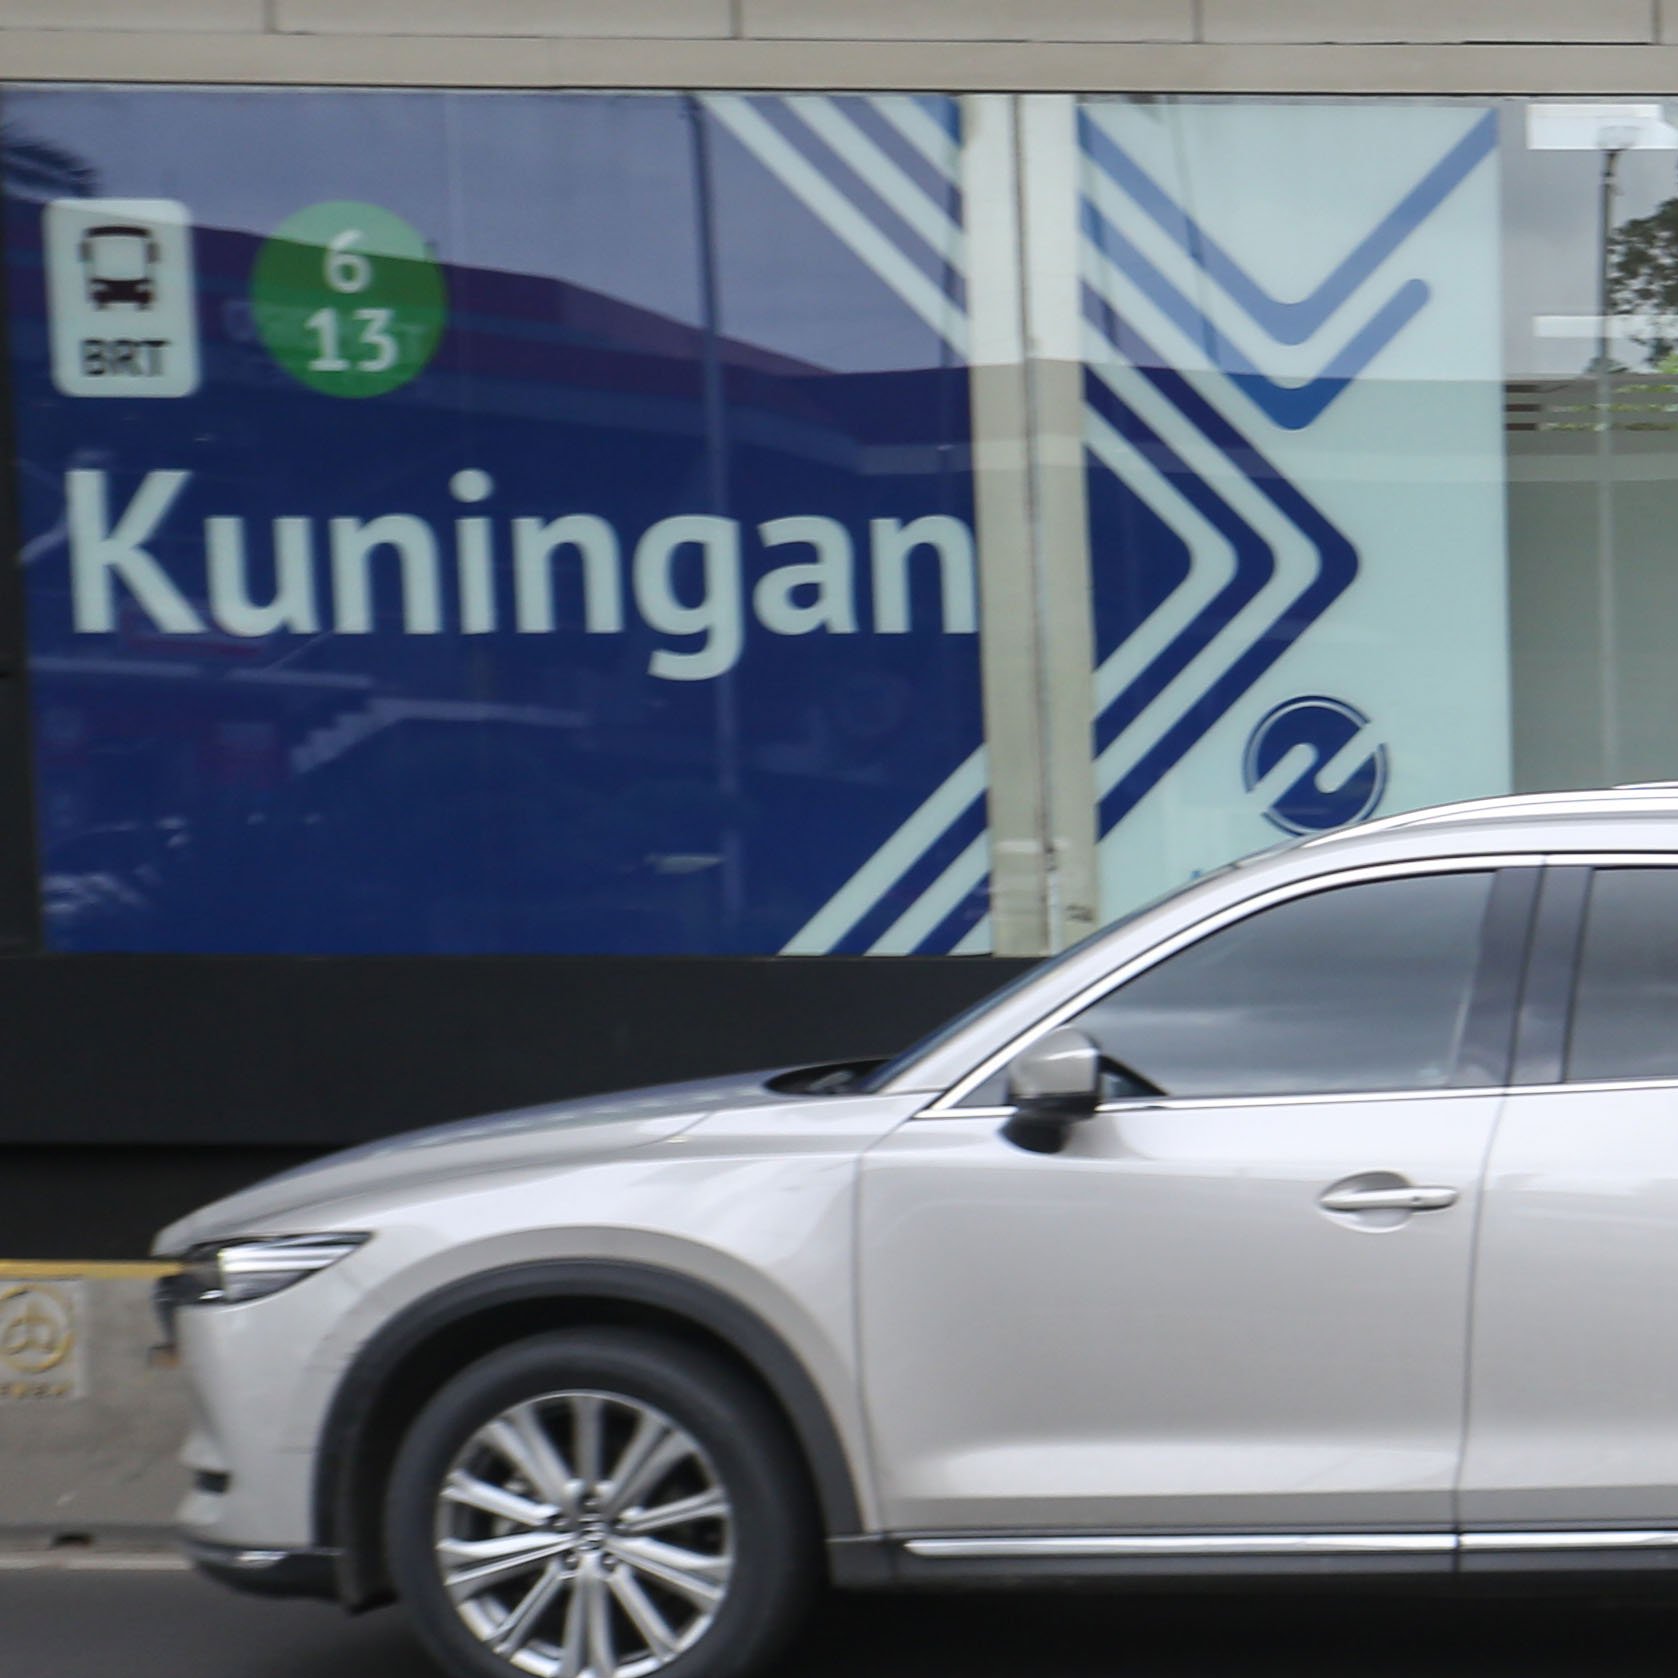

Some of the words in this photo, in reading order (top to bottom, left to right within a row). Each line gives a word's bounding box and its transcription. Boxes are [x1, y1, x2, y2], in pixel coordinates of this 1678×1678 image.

[324, 228, 373, 294] 6
[80, 337, 170, 377] BRT
[305, 306, 400, 374] 13
[66, 468, 979, 681] Kuningan
